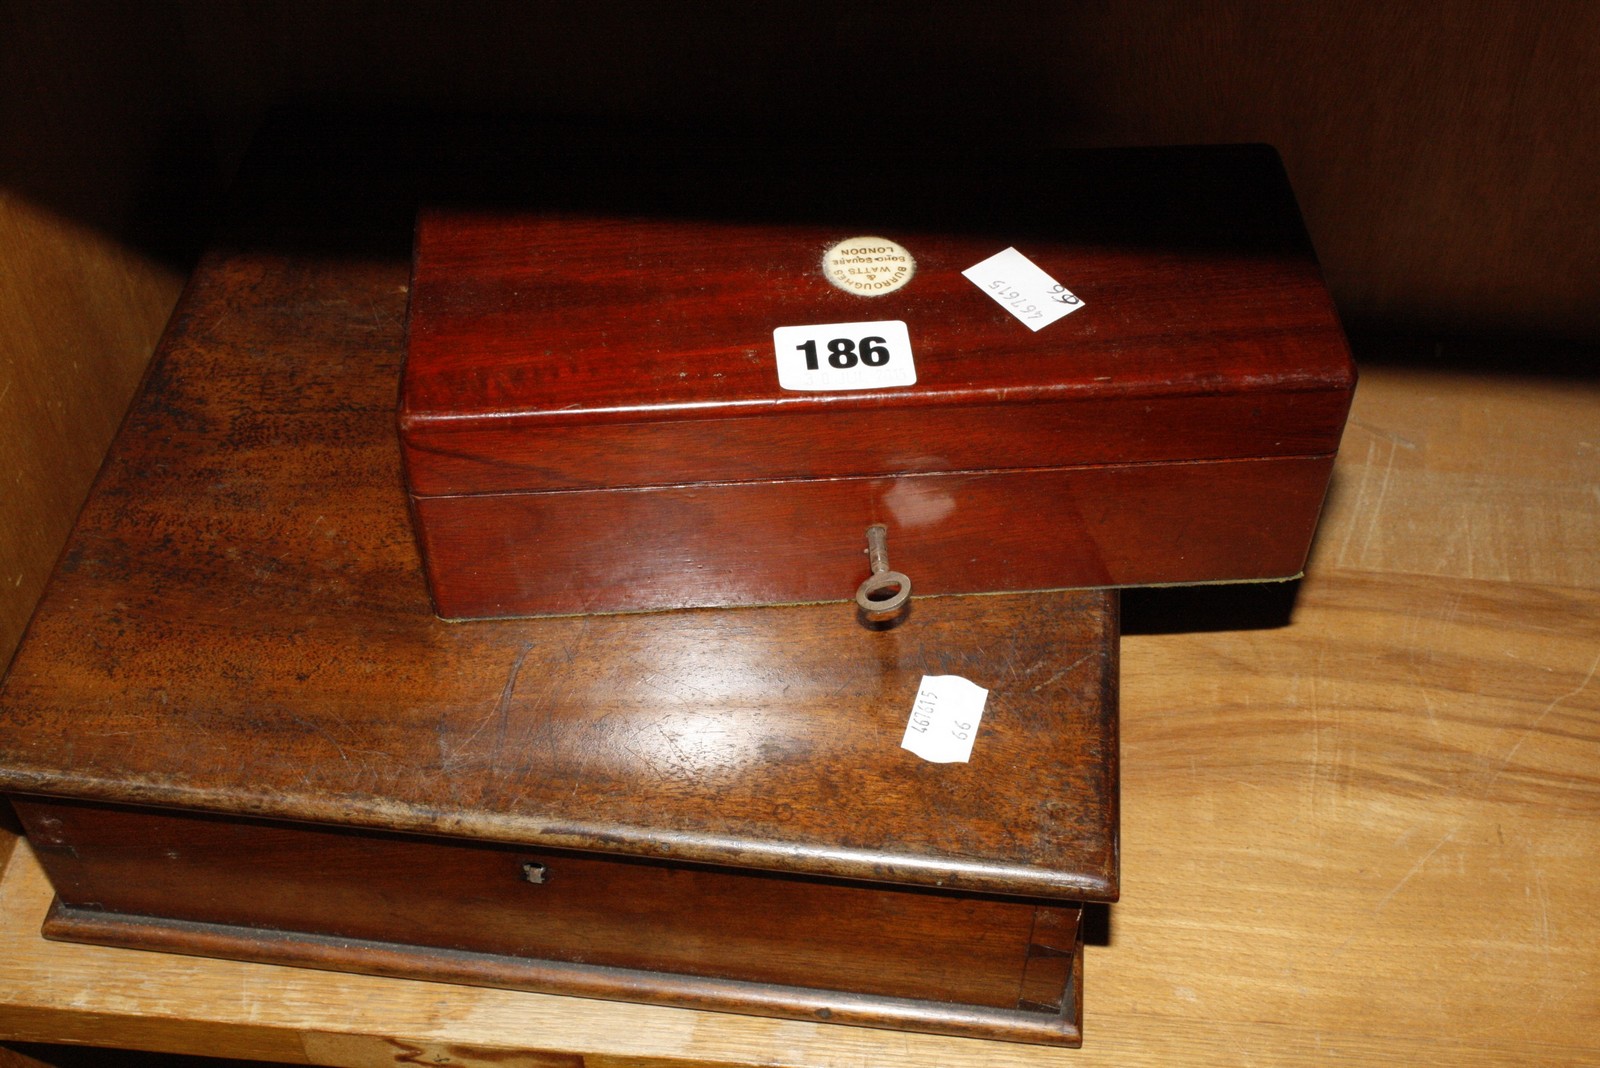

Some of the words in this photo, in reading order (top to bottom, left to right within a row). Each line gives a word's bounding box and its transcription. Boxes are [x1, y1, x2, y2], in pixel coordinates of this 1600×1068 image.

[832, 256, 873, 265] SQUARE
[841, 247, 894, 256] LONDON
[833, 266, 908, 291] BURROUGHES
[847, 266, 891, 275] WATTS
[988, 280, 1043, 320] 467615
[795, 335, 891, 371] 186
[951, 720, 972, 741] 66
